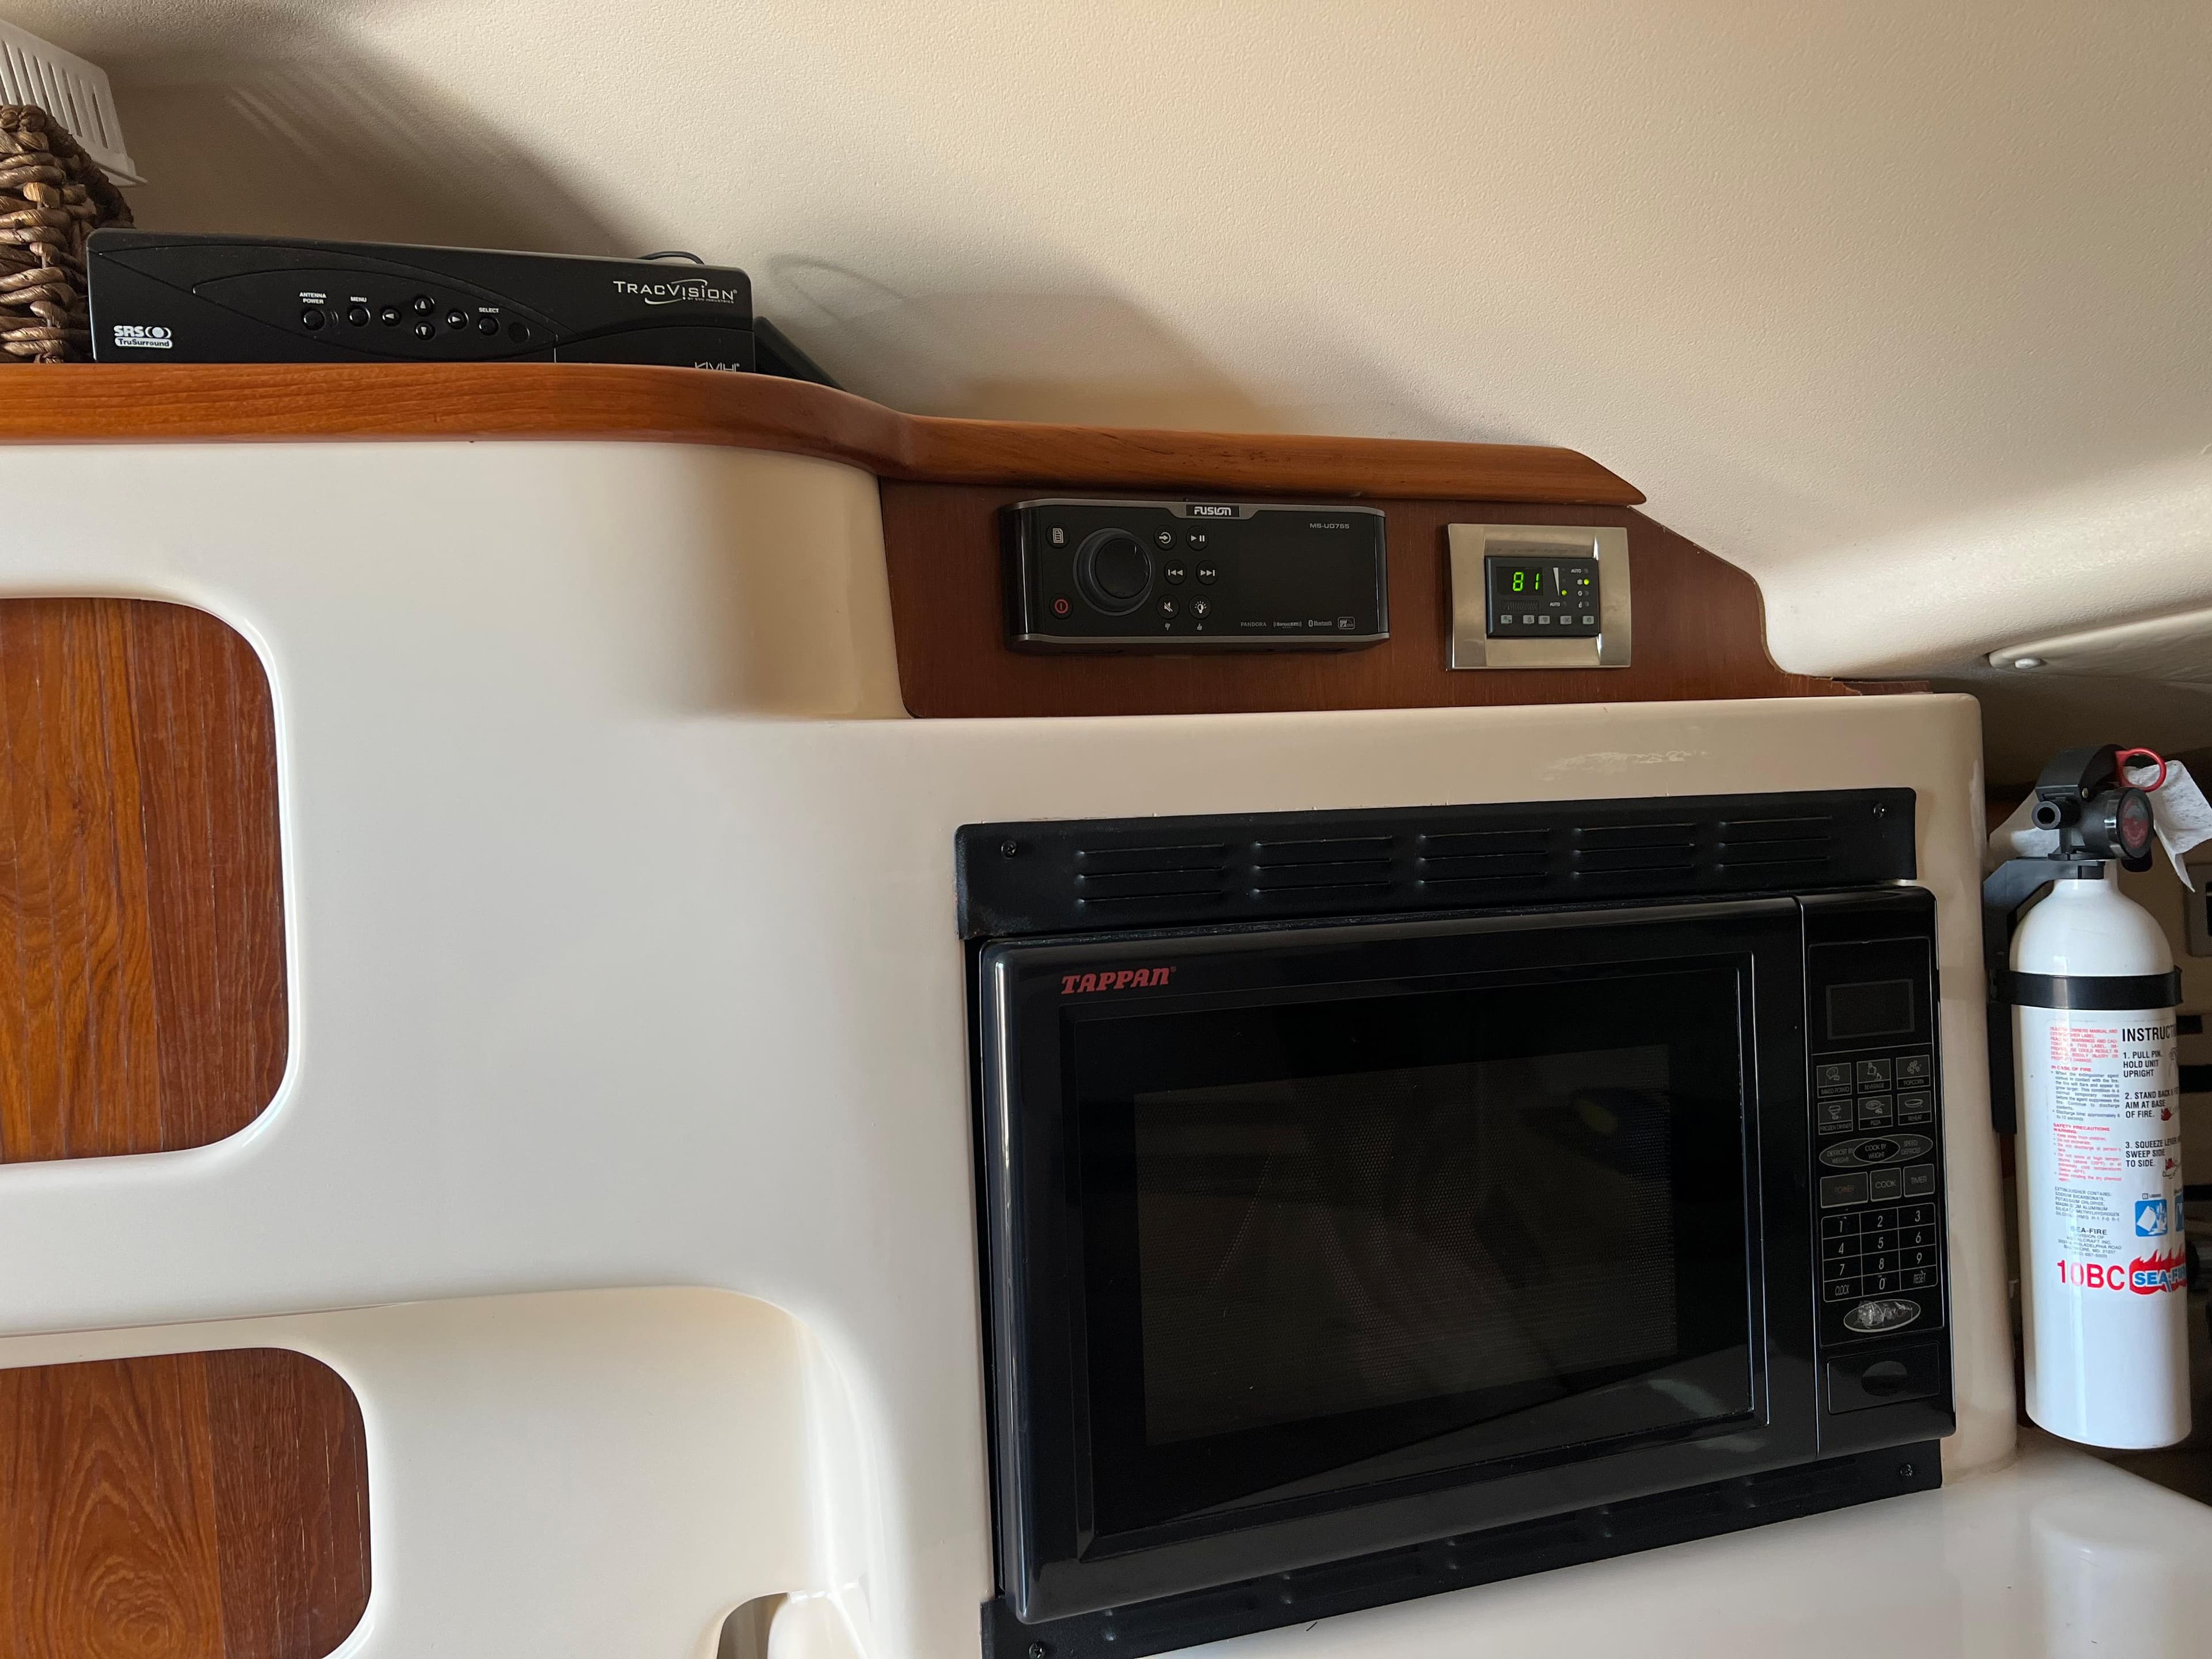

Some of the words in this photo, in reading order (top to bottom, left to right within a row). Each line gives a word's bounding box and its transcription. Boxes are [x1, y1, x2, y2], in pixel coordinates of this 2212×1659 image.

[113, 325, 145, 338] SRS
[118, 338, 170, 347] TruSurround
[1194, 506, 1232, 516] FUSION
[1512, 571, 1540, 592] 81
[1061, 967, 1169, 994] TAPPAN
[2123, 1060, 2143, 1069] HOLD
[2145, 1059, 2159, 1067] UNIT
[2124, 1069, 2154, 1078] UPRIGHT
[2134, 1091, 2156, 1099] STAND
[2142, 1100, 2150, 1108] AT
[2152, 1100, 2166, 1108] BASE
[2135, 1139, 2164, 1149] SQUEEZE
[2126, 1150, 2150, 1158] SWEEP
[2152, 1149, 2165, 1157] SIDE
[2138, 1159, 2156, 1167] SIDE.
[1875, 1180, 1896, 1189] COOK
[1911, 1176, 1927, 1185] TIMER
[1877, 1215, 1883, 1228] 2
[1915, 1210, 1921, 1222] 3
[1839, 1221, 1843, 1233] 1
[2070, 1226, 2107, 1235] SEA-FIRE
[1877, 1237, 1883, 1248] 5
[1915, 1232, 1921, 1243] 6
[1838, 1242, 1844, 1254] 4
[1878, 1257, 1884, 1270] 8
[1916, 1252, 1922, 1264] 9
[1840, 1263, 1845, 1275] 7
[2056, 1259, 2125, 1291] 10BC
[1879, 1277, 1885, 1290] 0
[1835, 1285, 1850, 1296] CLOCK
